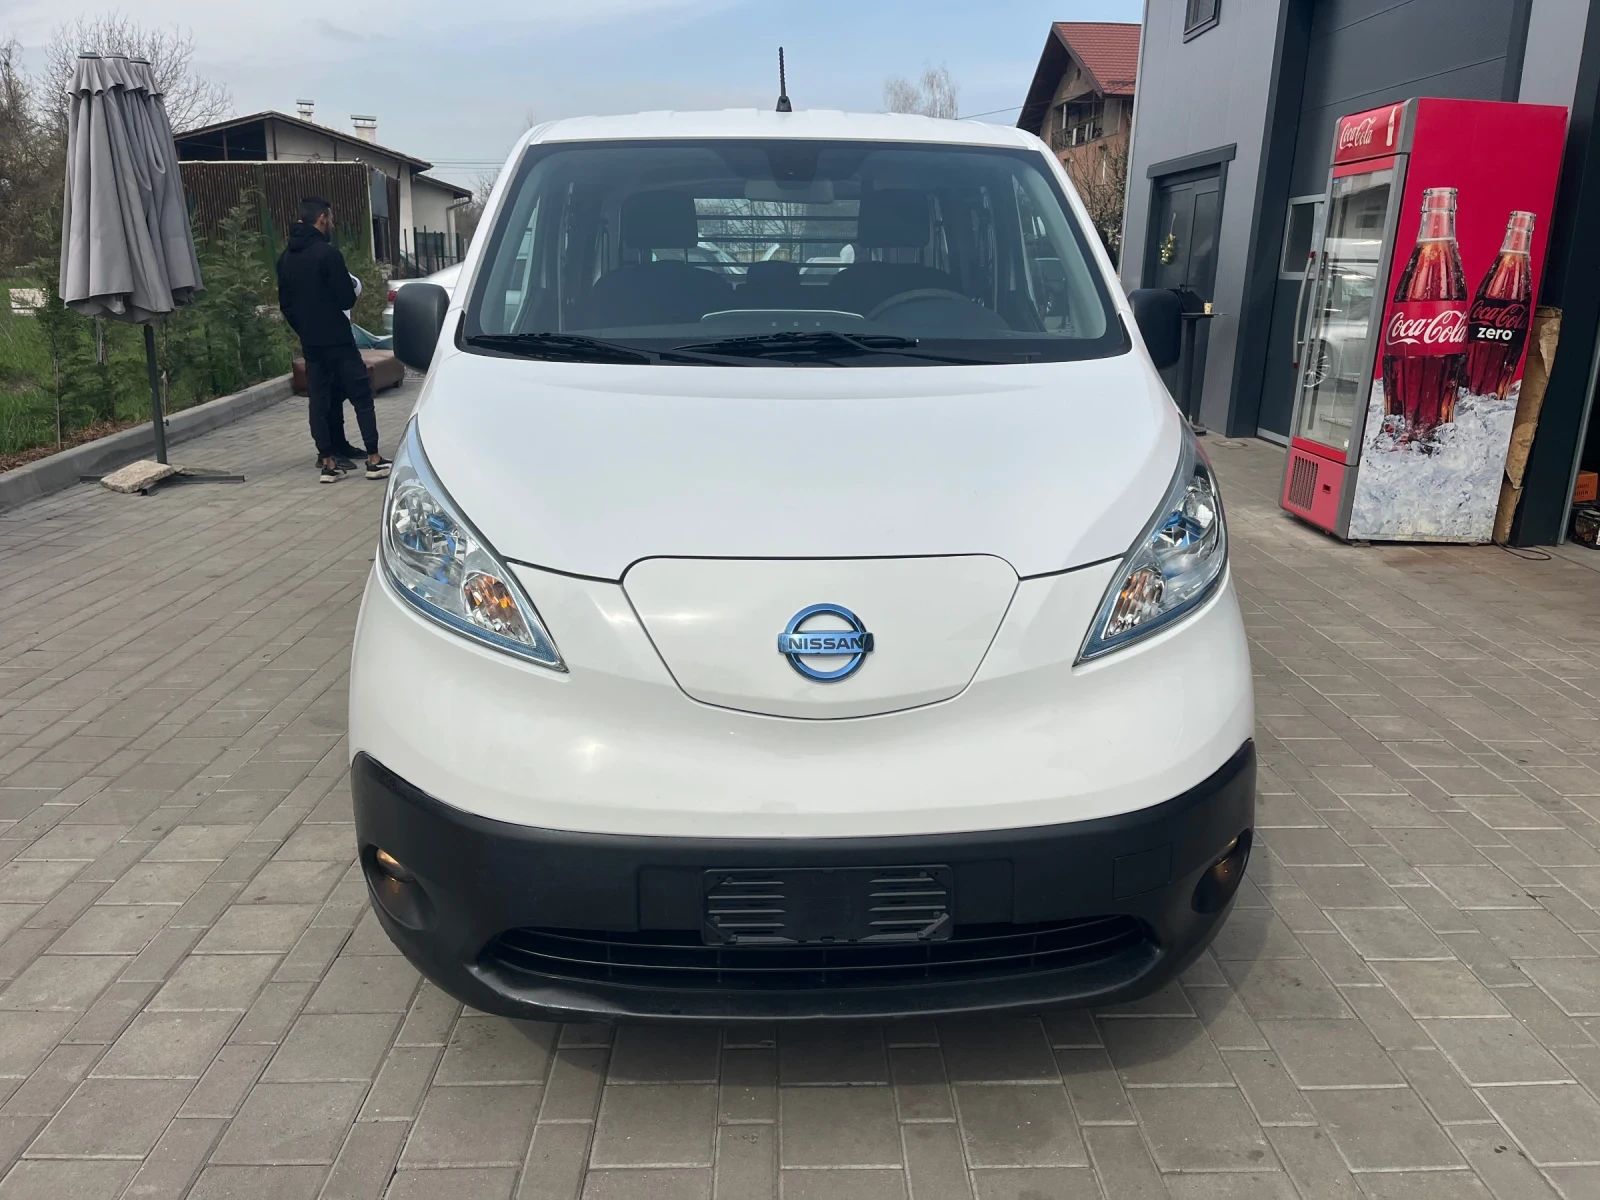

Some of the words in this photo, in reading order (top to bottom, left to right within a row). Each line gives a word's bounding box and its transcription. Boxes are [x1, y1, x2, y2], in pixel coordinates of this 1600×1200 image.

[1340, 117, 1377, 149] Coca-Cola
[1386, 310, 1468, 346] Coca-Cola
[1468, 300, 1529, 330] Coca-Cola
[1477, 326, 1512, 341] zero
[788, 637, 864, 650] NISSAN
